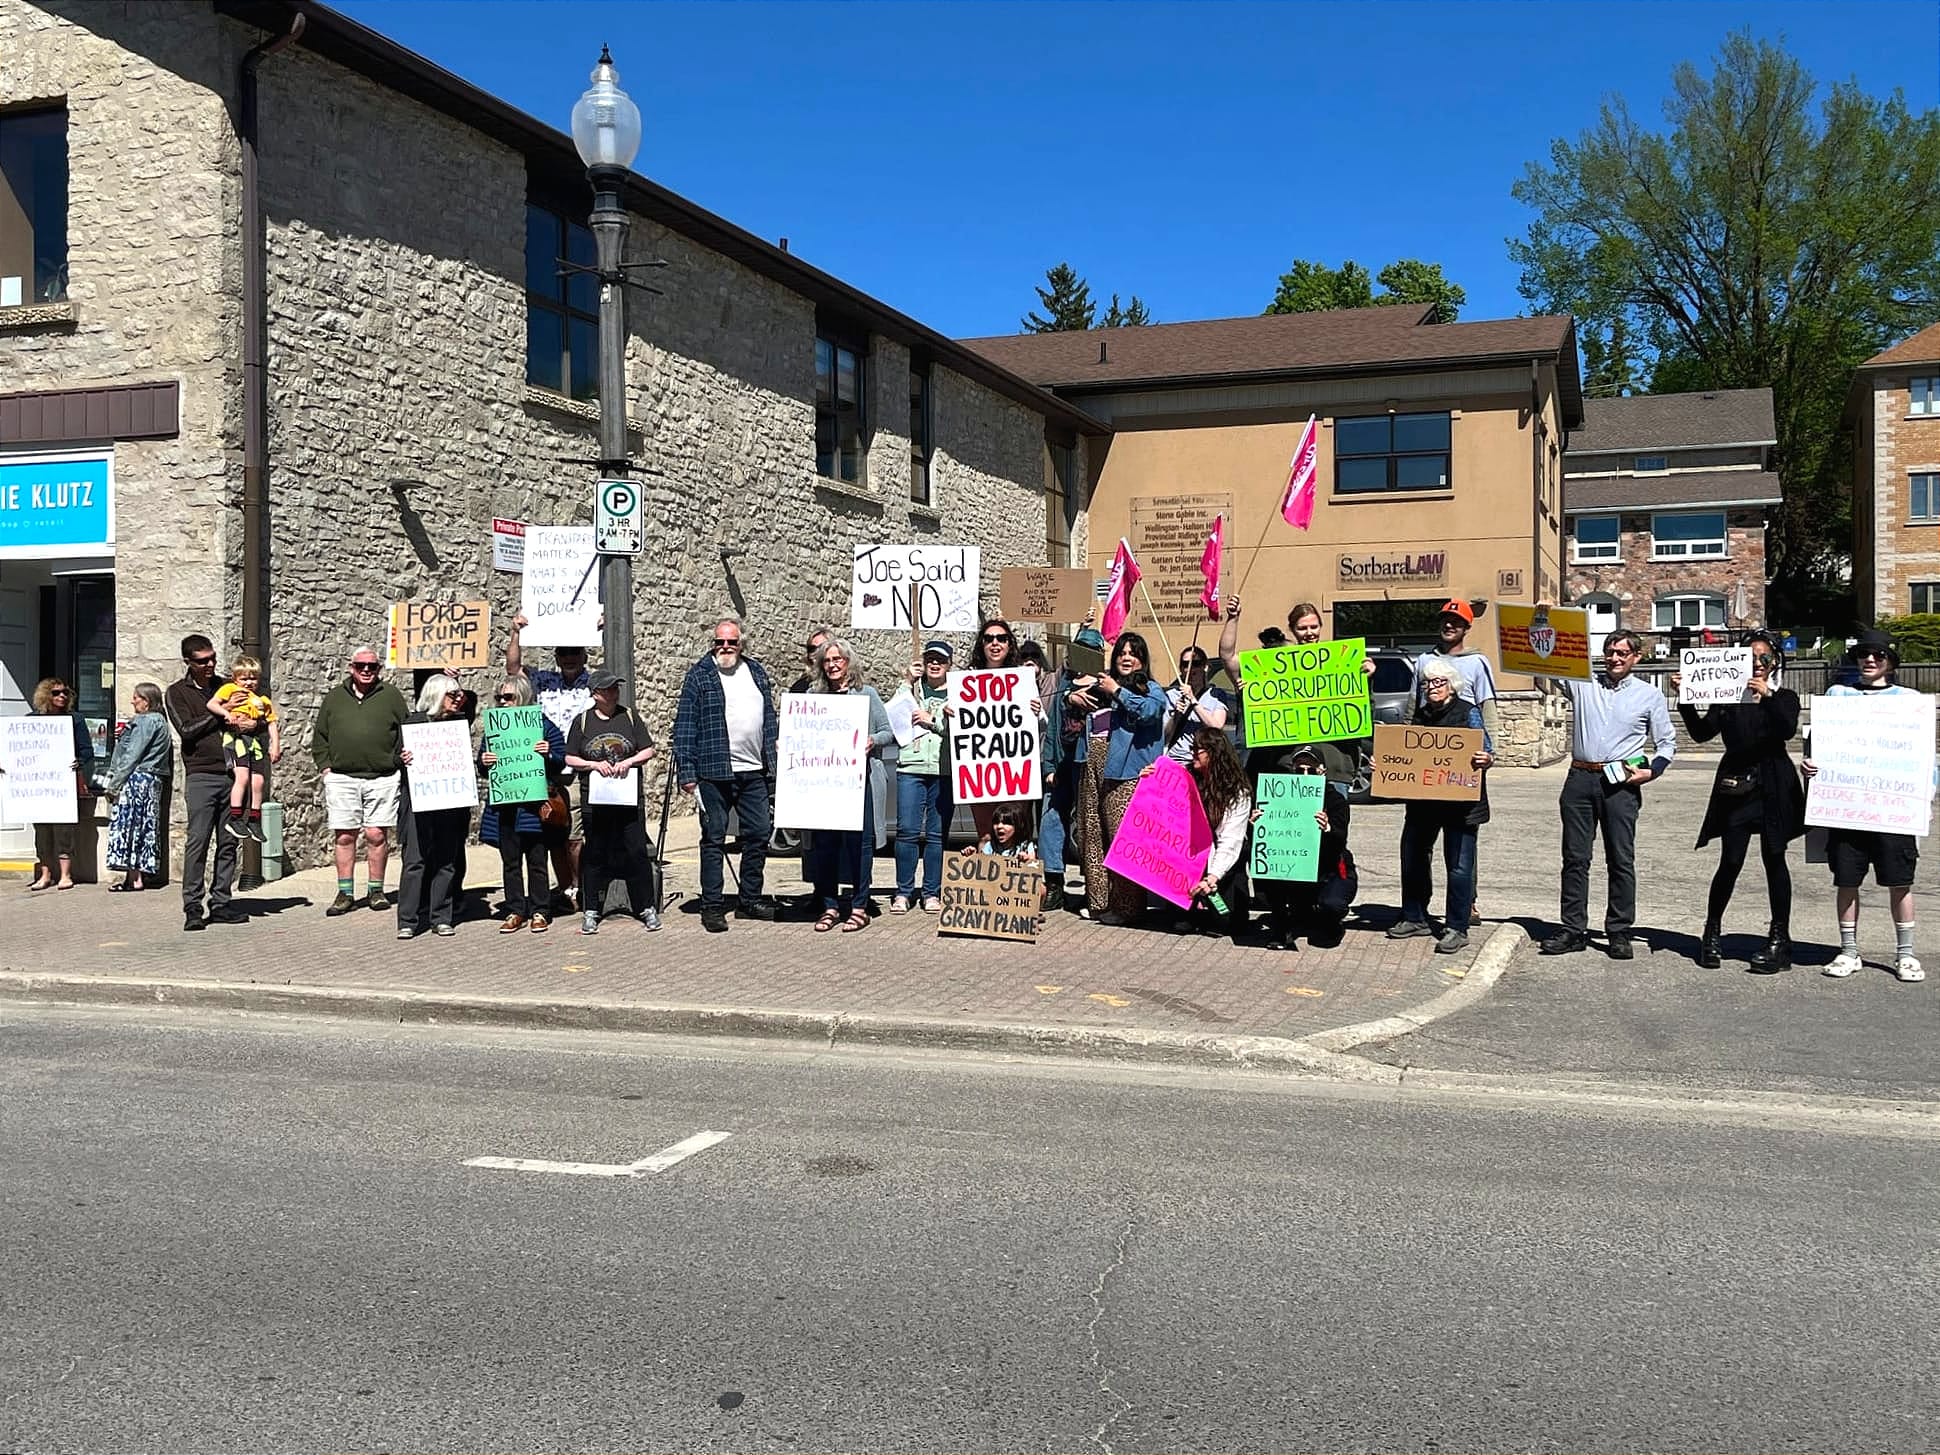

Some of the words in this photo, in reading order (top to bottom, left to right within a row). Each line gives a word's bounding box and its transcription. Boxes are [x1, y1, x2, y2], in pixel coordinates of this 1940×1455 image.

[31, 481, 93, 510] KLUTZ
[613, 492, 628, 509] P
[599, 527, 604, 537] 9
[606, 528, 617, 538] AM
[629, 529, 639, 538] PM
[608, 517, 615, 527] 3
[617, 518, 630, 528] HR
[856, 546, 903, 584] Joe
[908, 548, 966, 584] Said
[1026, 571, 1055, 581] WAKE
[1501, 573, 1519, 586] 181
[892, 584, 941, 629] NO
[1021, 606, 1056, 617] BEHALF
[1030, 600, 1049, 608] OUR
[402, 621, 477, 644] TRUMP
[1530, 629, 1553, 642] STOP
[406, 641, 476, 664] NORTH
[1272, 647, 1330, 674] STOP
[960, 673, 1019, 703] STOP
[1248, 671, 1362, 702] CORRUPTION
[1686, 687, 1710, 701] DOUG
[489, 710, 510, 731] NO
[514, 709, 543, 729] MORE
[959, 704, 1022, 730] DOUG
[1251, 708, 1300, 740] FIRE!
[1307, 702, 1368, 737] FORD!
[487, 734, 531, 752] FAILING
[954, 730, 1034, 760] FRAUD
[1405, 730, 1464, 750] DOUG
[16, 754, 40, 768] NOT
[1382, 754, 1413, 766] SHOW
[1433, 757, 1451, 767] US
[490, 769, 545, 788] RESIDENTS
[959, 759, 1031, 799] NOW
[1380, 770, 1416, 784] YOUR
[491, 787, 529, 803] DAILY
[1264, 777, 1285, 798] NO
[1291, 777, 1322, 799] MORE
[1131, 811, 1198, 862] ONTARIO
[1257, 825, 1302, 839] ONTARIO
[1255, 842, 1308, 859] RESIDENTS
[947, 857, 1000, 882] SOLD
[1004, 859, 1022, 869] THE
[1112, 836, 1195, 893] CORRUPTION
[1255, 859, 1295, 876] DAILY
[943, 886, 989, 906] STILL
[996, 896, 1010, 906] ON
[1014, 897, 1032, 908] THE
[940, 904, 992, 931] GRAVY
